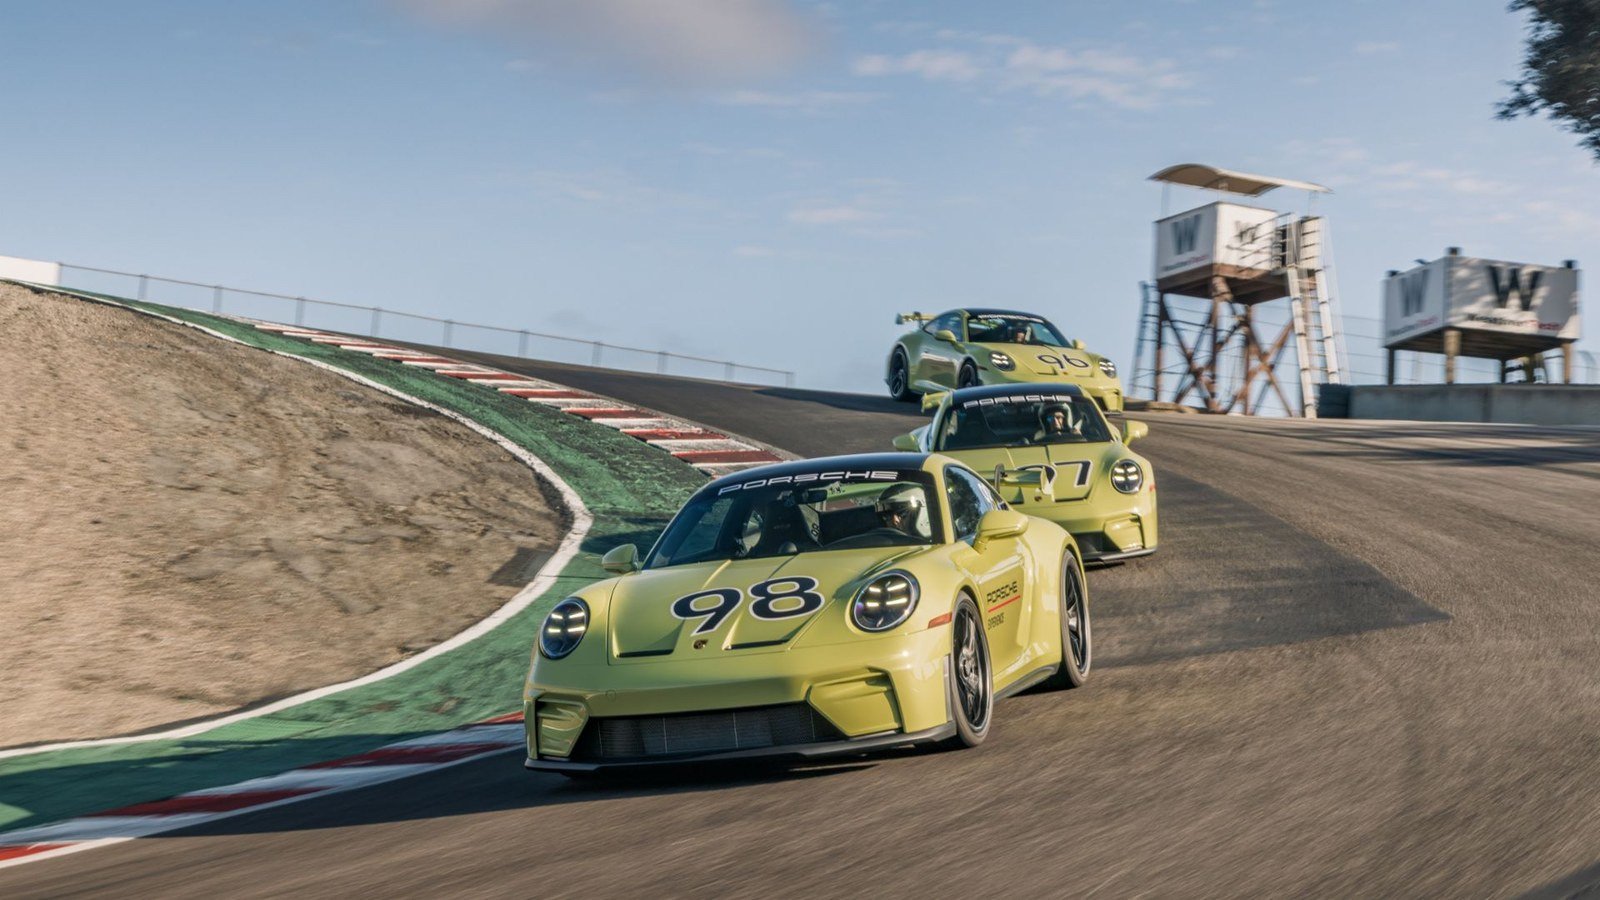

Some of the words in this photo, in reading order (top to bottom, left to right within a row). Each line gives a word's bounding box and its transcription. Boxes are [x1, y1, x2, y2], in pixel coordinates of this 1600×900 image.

[1485, 264, 1544, 311] W
[1037, 354, 1090, 369] 96
[963, 394, 1073, 409] PORSCHE
[718, 470, 899, 496] PORSCHE
[986, 580, 1018, 603] PORSCHE
[670, 575, 825, 637] 98
